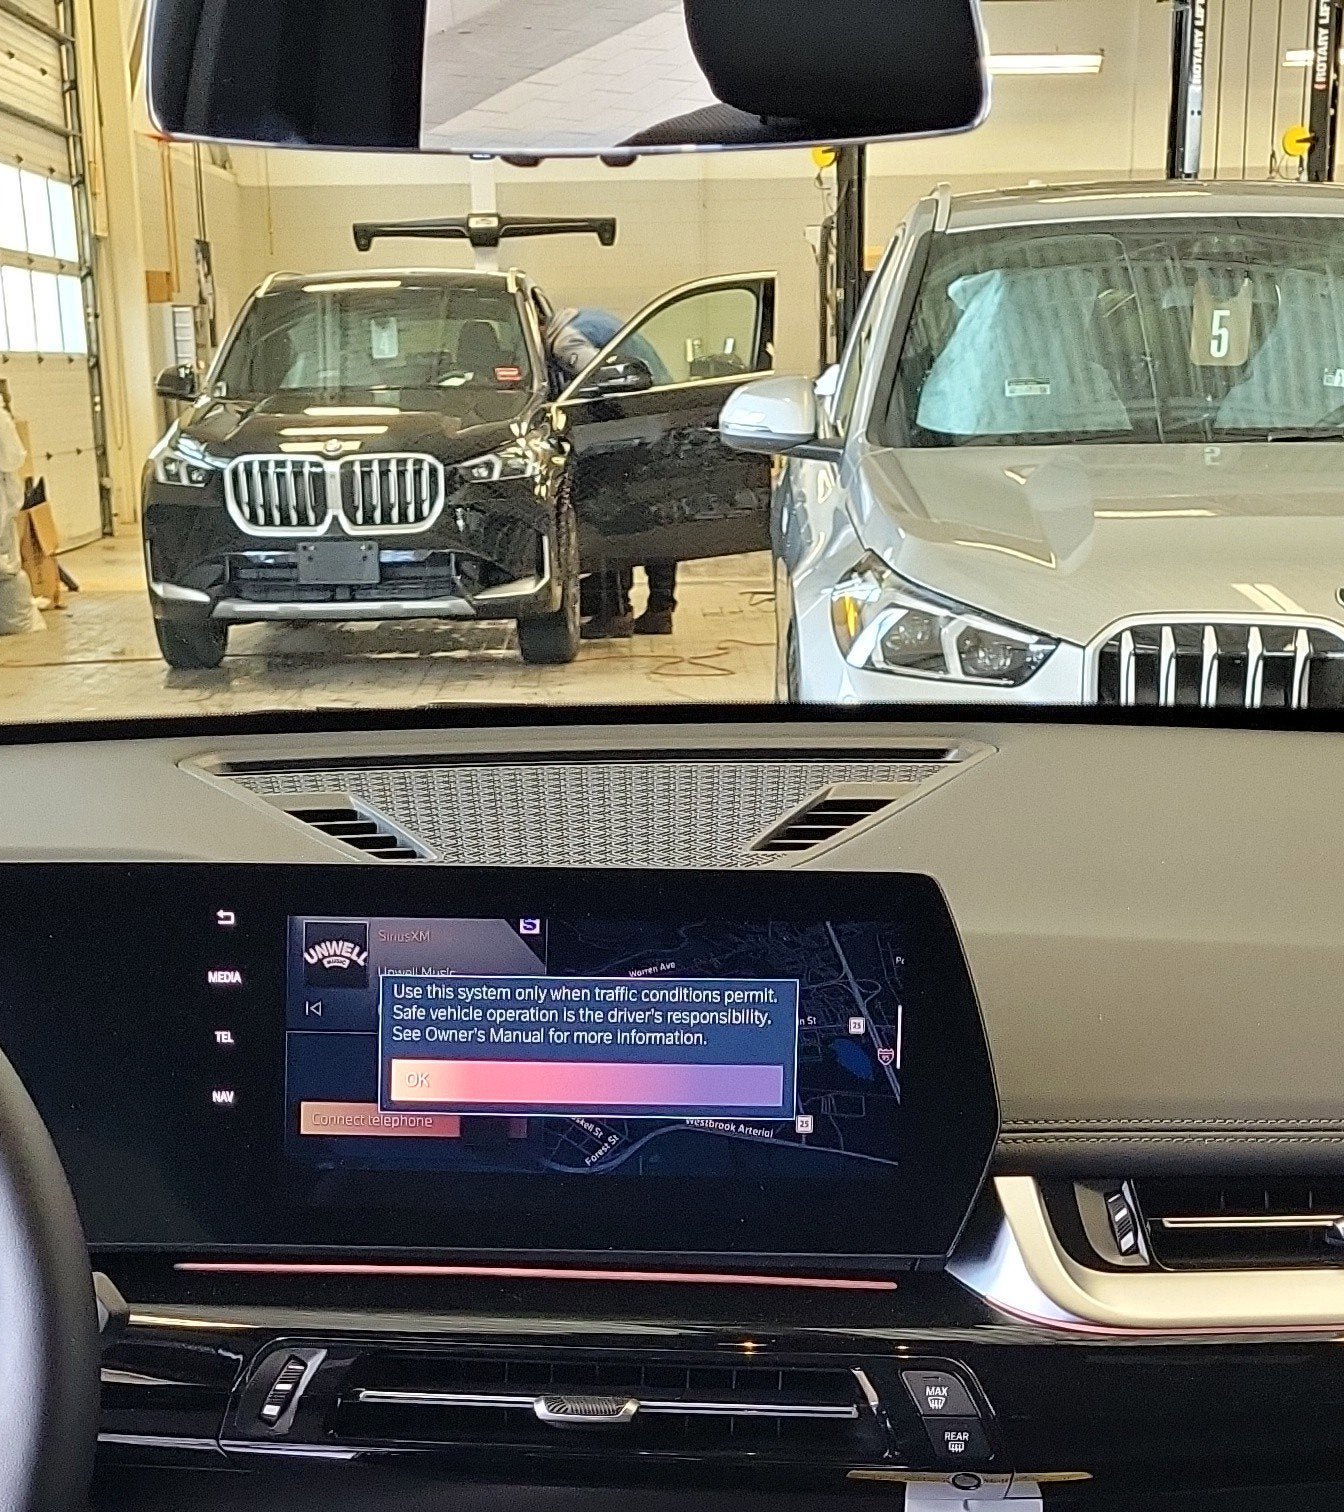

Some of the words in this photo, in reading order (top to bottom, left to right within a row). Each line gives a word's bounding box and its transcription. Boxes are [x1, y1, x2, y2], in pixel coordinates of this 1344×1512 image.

[1210, 309, 1230, 358] 5
[378, 930, 431, 943] SiriusXM
[303, 940, 368, 967] UNWELL
[207, 971, 242, 984] MEDIA
[628, 965, 659, 979] Warren
[660, 961, 676, 971] Ave
[393, 984, 422, 999] Use
[426, 984, 454, 1000] this
[458, 985, 510, 1003] system
[515, 986, 547, 1003] only
[550, 986, 590, 1001] when
[594, 986, 638, 1002] traffic
[641, 987, 721, 1003] conditions
[724, 987, 778, 1006] permit.
[392, 1005, 426, 1020] Safe
[430, 1005, 483, 1021] vehicle
[487, 1006, 558, 1025] operation
[563, 1007, 576, 1022] is
[579, 1008, 604, 1022] the
[607, 1008, 662, 1023] driver's
[667, 1009, 772, 1027] responsibility.
[807, 1016, 817, 1025] St
[214, 1031, 235, 1044] TEL
[392, 1026, 421, 1042] See
[425, 1027, 485, 1043] Owner's
[490, 1028, 544, 1044] Manual
[549, 1028, 571, 1044] for
[573, 1030, 613, 1045] more
[617, 1029, 707, 1046] information.
[406, 1071, 430, 1088] OK
[212, 1090, 235, 1103] NAV
[312, 1113, 365, 1126] Connect
[368, 1114, 433, 1129] telephone
[685, 1118, 736, 1132] Westbrook
[737, 1123, 774, 1138] Arterial
[800, 1120, 809, 1128] 25
[593, 1127, 604, 1139] St
[585, 1143, 611, 1166] Forest
[607, 1135, 620, 1146] St
[925, 1386, 949, 1397] MAX
[944, 1431, 969, 1442] REAR
